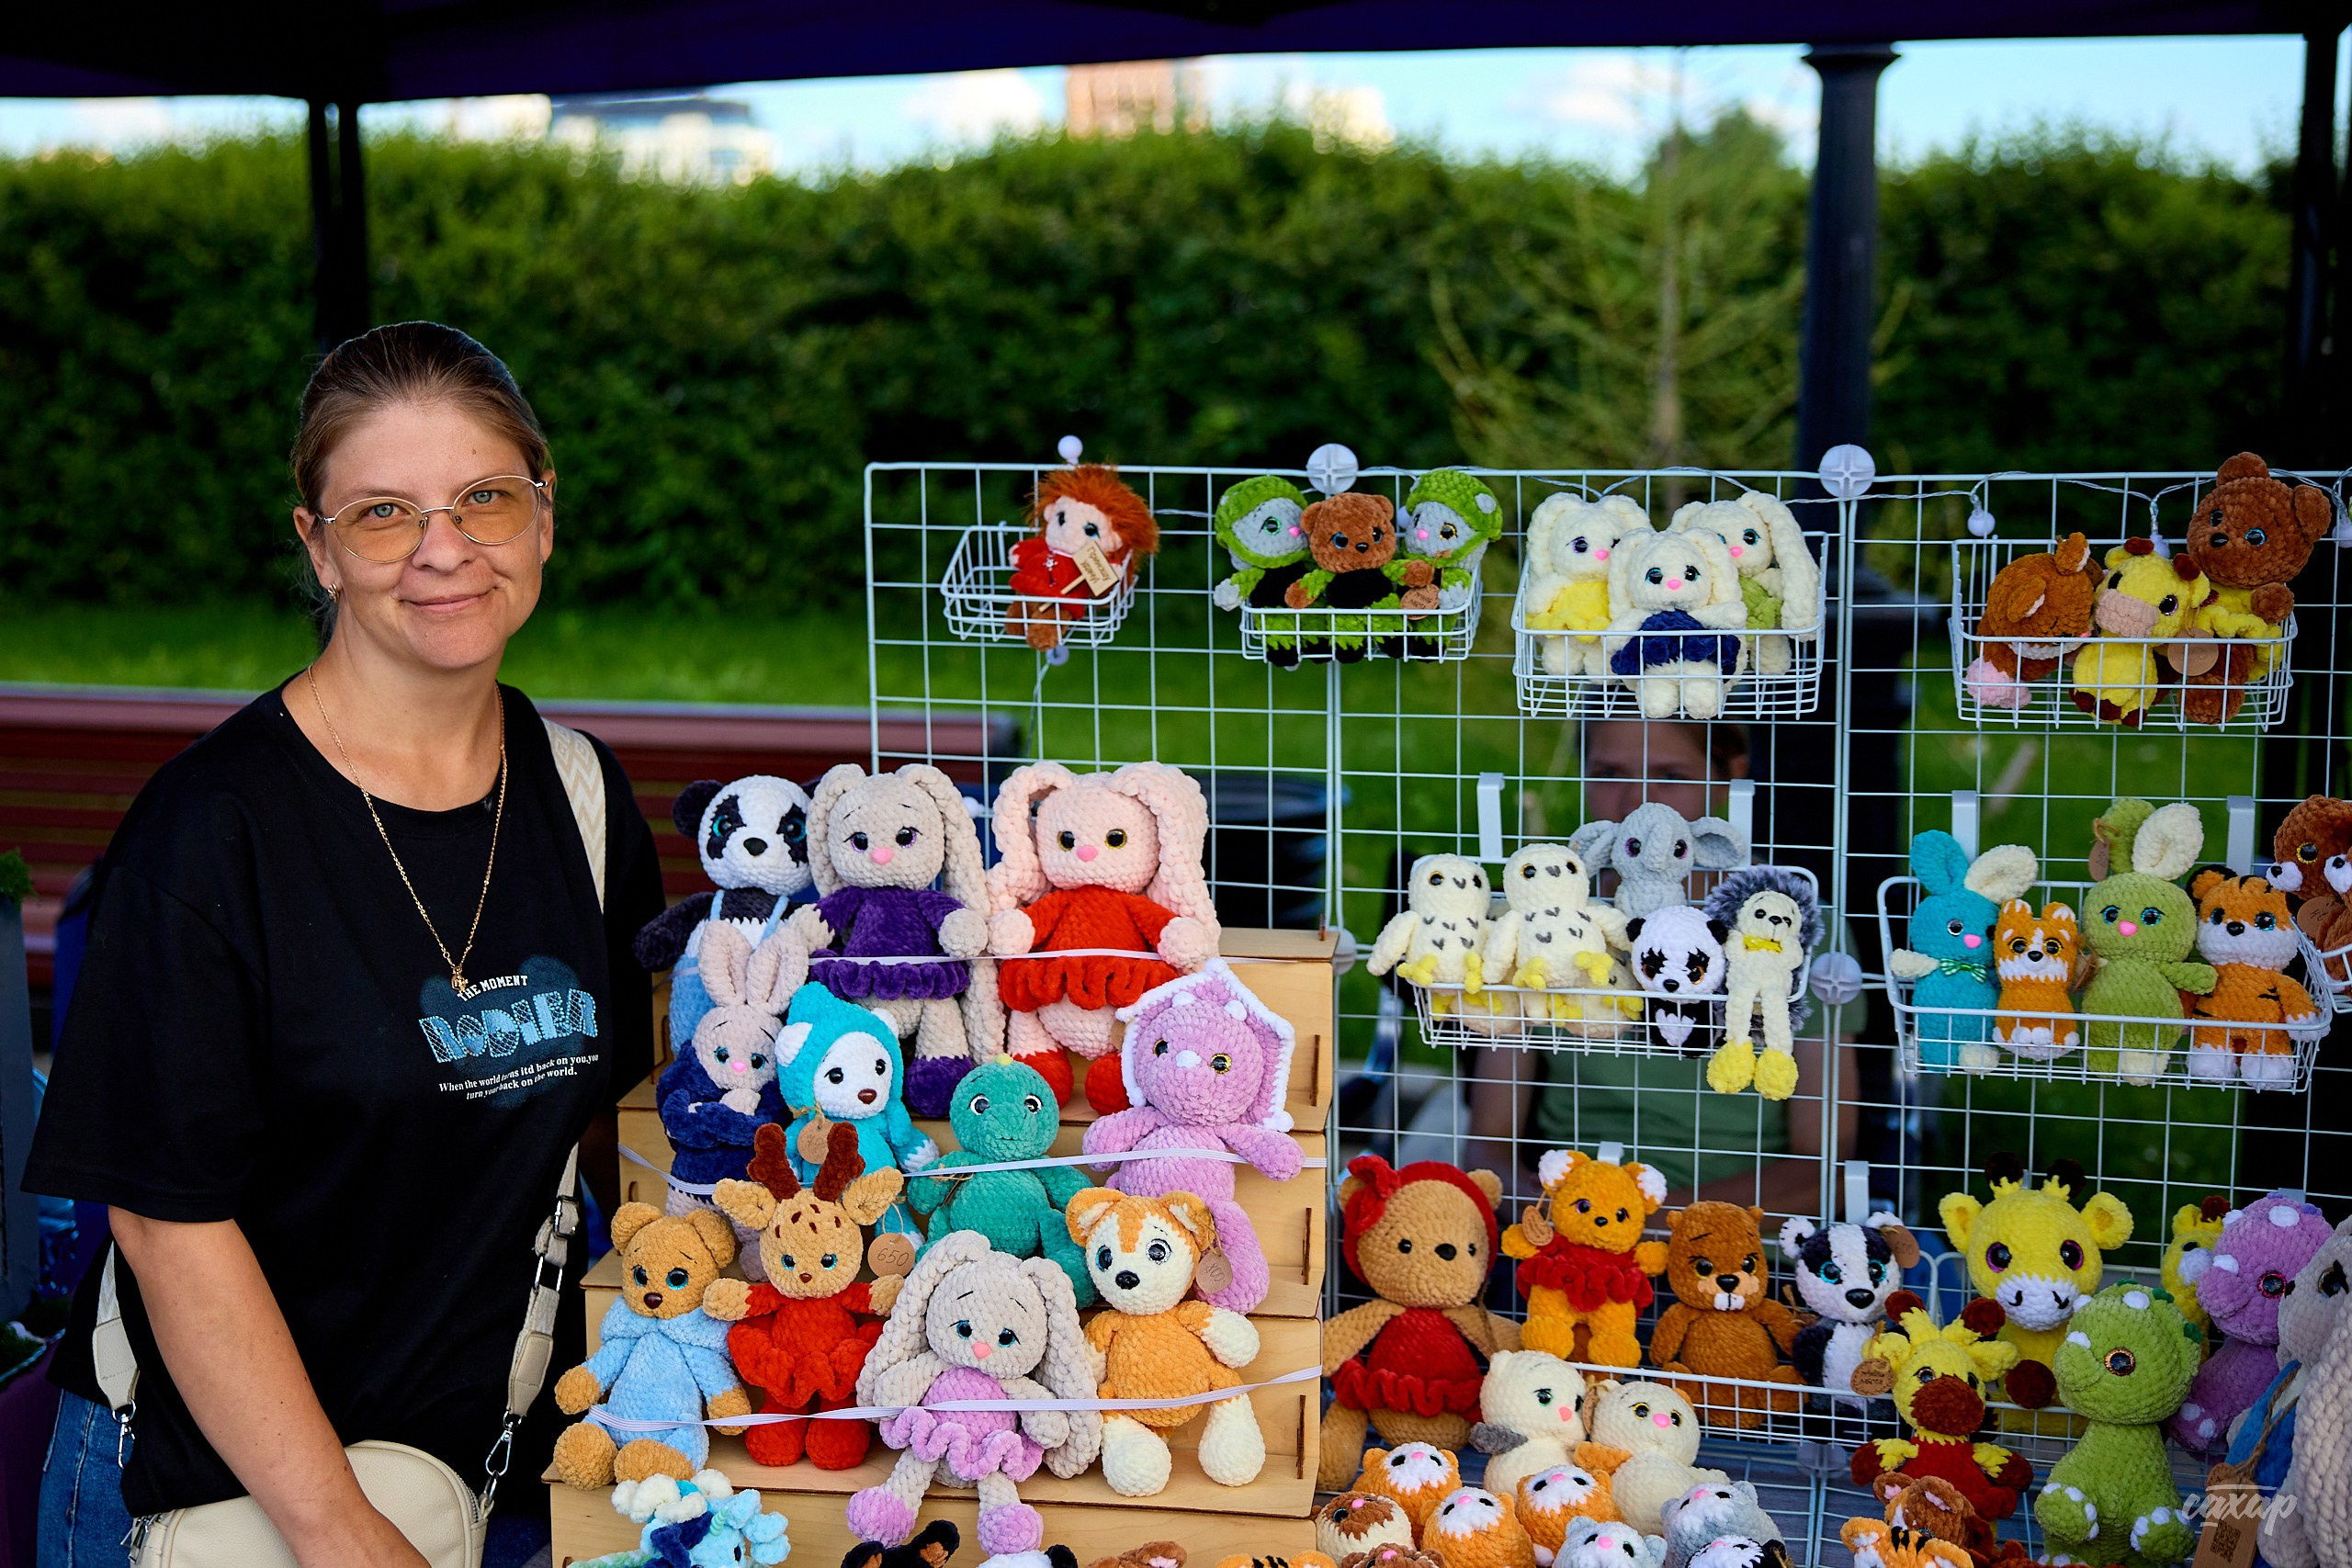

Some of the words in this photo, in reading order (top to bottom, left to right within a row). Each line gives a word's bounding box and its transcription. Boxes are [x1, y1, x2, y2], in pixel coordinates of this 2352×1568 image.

[457, 984, 481, 1002] THE
[479, 975, 528, 992] MOMENT
[439, 1082, 464, 1092] When
[464, 1079, 478, 1089] the
[478, 1074, 501, 1087] world
[536, 1058, 556, 1073] back
[556, 1057, 569, 1066] on
[466, 1090, 483, 1100] turn
[498, 1078, 520, 1091] back
[520, 1078, 534, 1088] on
[534, 1073, 546, 1083] the
[547, 1066, 578, 1077] world.
[876, 1247, 910, 1267] 650
